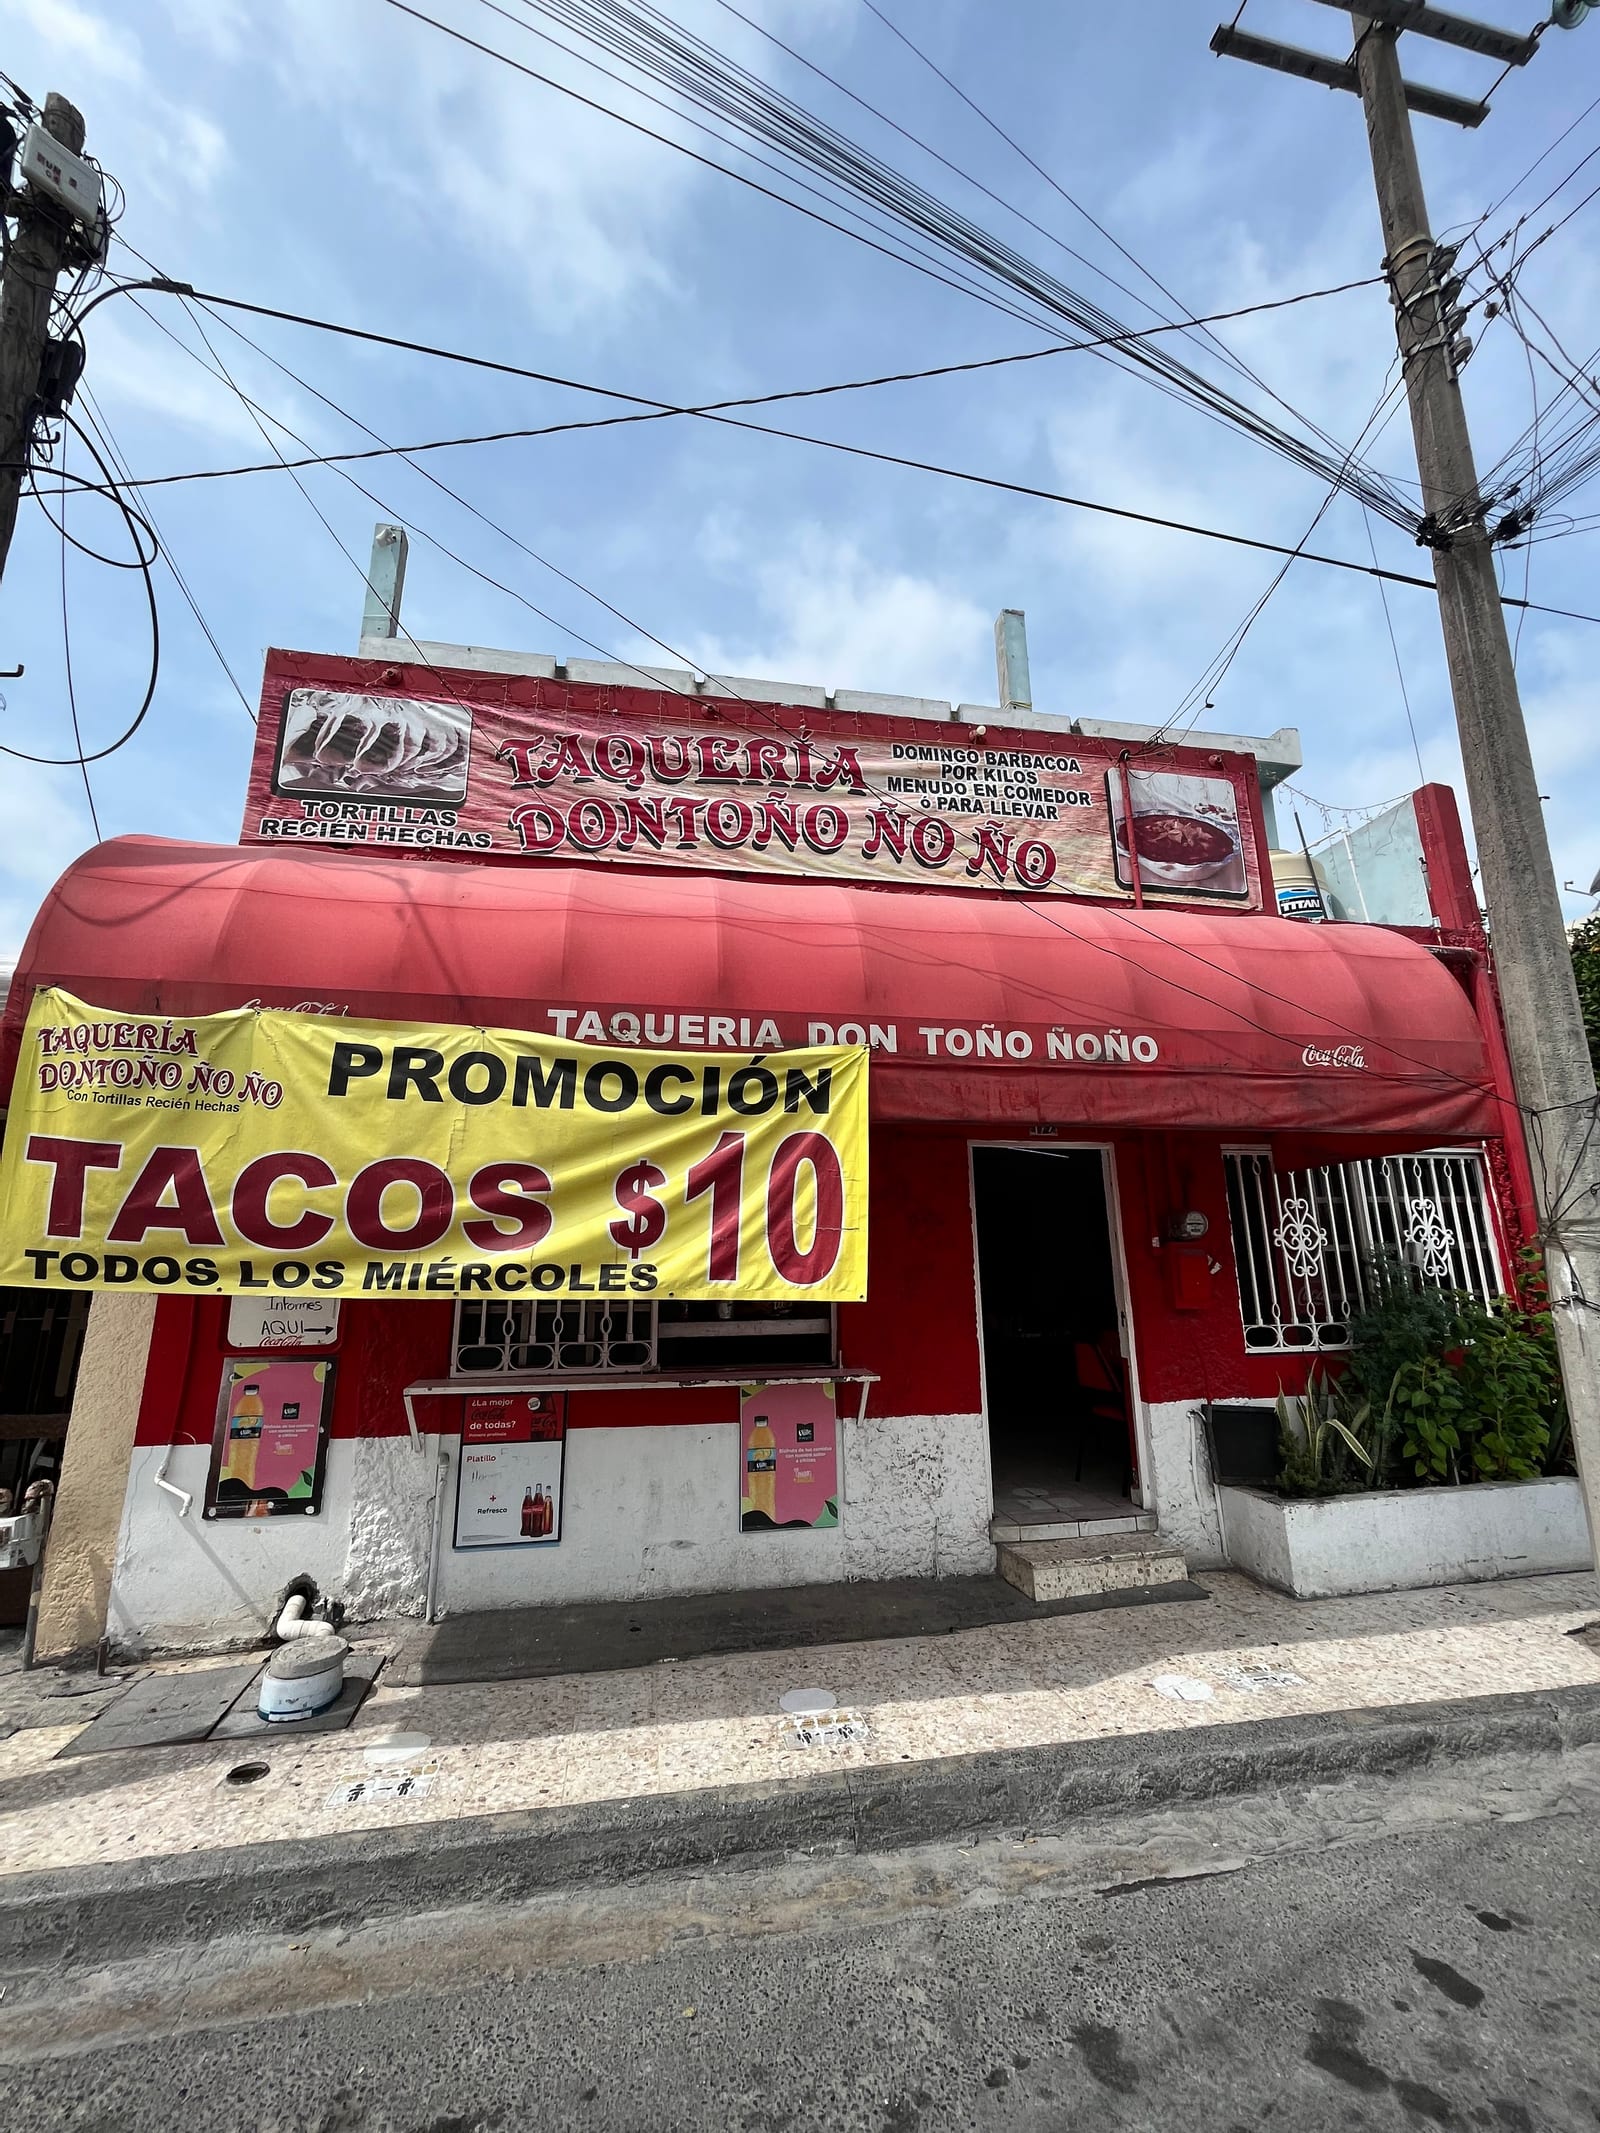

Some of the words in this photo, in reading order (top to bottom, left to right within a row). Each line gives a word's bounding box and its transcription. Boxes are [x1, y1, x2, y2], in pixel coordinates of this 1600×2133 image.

[496, 727, 868, 796] TAQUERÍA
[892, 743, 980, 764] DOMINGO
[985, 751, 1083, 774] BARBACOA
[941, 764, 978, 781] POR
[983, 767, 1038, 785] KILOS
[887, 776, 968, 796] MENUDO
[973, 783, 998, 798] EN
[1000, 785, 1092, 807] COMEDOR
[300, 800, 458, 828] TORTILLAS
[937, 796, 985, 815] PARA
[990, 801, 1059, 821] LLEVAR
[260, 818, 369, 841] RECIÉN
[376, 828, 492, 848] HECHAS
[508, 791, 850, 855] DONTOÑO
[861, 801, 956, 870] ÑO
[965, 819, 1058, 891] ÑO
[1280, 899, 1320, 912] TITAN
[38, 1019, 200, 1056] TAQUERÍA
[547, 1008, 785, 1049] TAQUERIA
[807, 1021, 898, 1054] DON
[918, 1022, 1033, 1059] TOÑO
[1046, 1025, 1159, 1063] ÑOÑO
[38, 1055, 184, 1092] DONTOÑO
[187, 1060, 236, 1098] ÑO
[238, 1071, 285, 1110] ÑO
[328, 1041, 833, 1116] PROMOCIÓN
[67, 1089, 89, 1102] Con
[92, 1091, 142, 1106] Tortillas
[146, 1095, 191, 1110] Recién
[195, 1099, 240, 1113] Hechas
[26, 1134, 554, 1253] TACOS
[608, 1131, 845, 1285] $10
[24, 1249, 220, 1287] TODOS
[239, 1259, 345, 1291] LOS
[362, 1256, 659, 1293] MIÉRCOLES
[261, 1320, 304, 1336] AQUI
[489, 1398, 514, 1408] mejor
[469, 1421, 482, 1430] de
[484, 1420, 517, 1430] todas?
[466, 1455, 497, 1463] Platillo
[477, 1506, 508, 1515] Refresco
